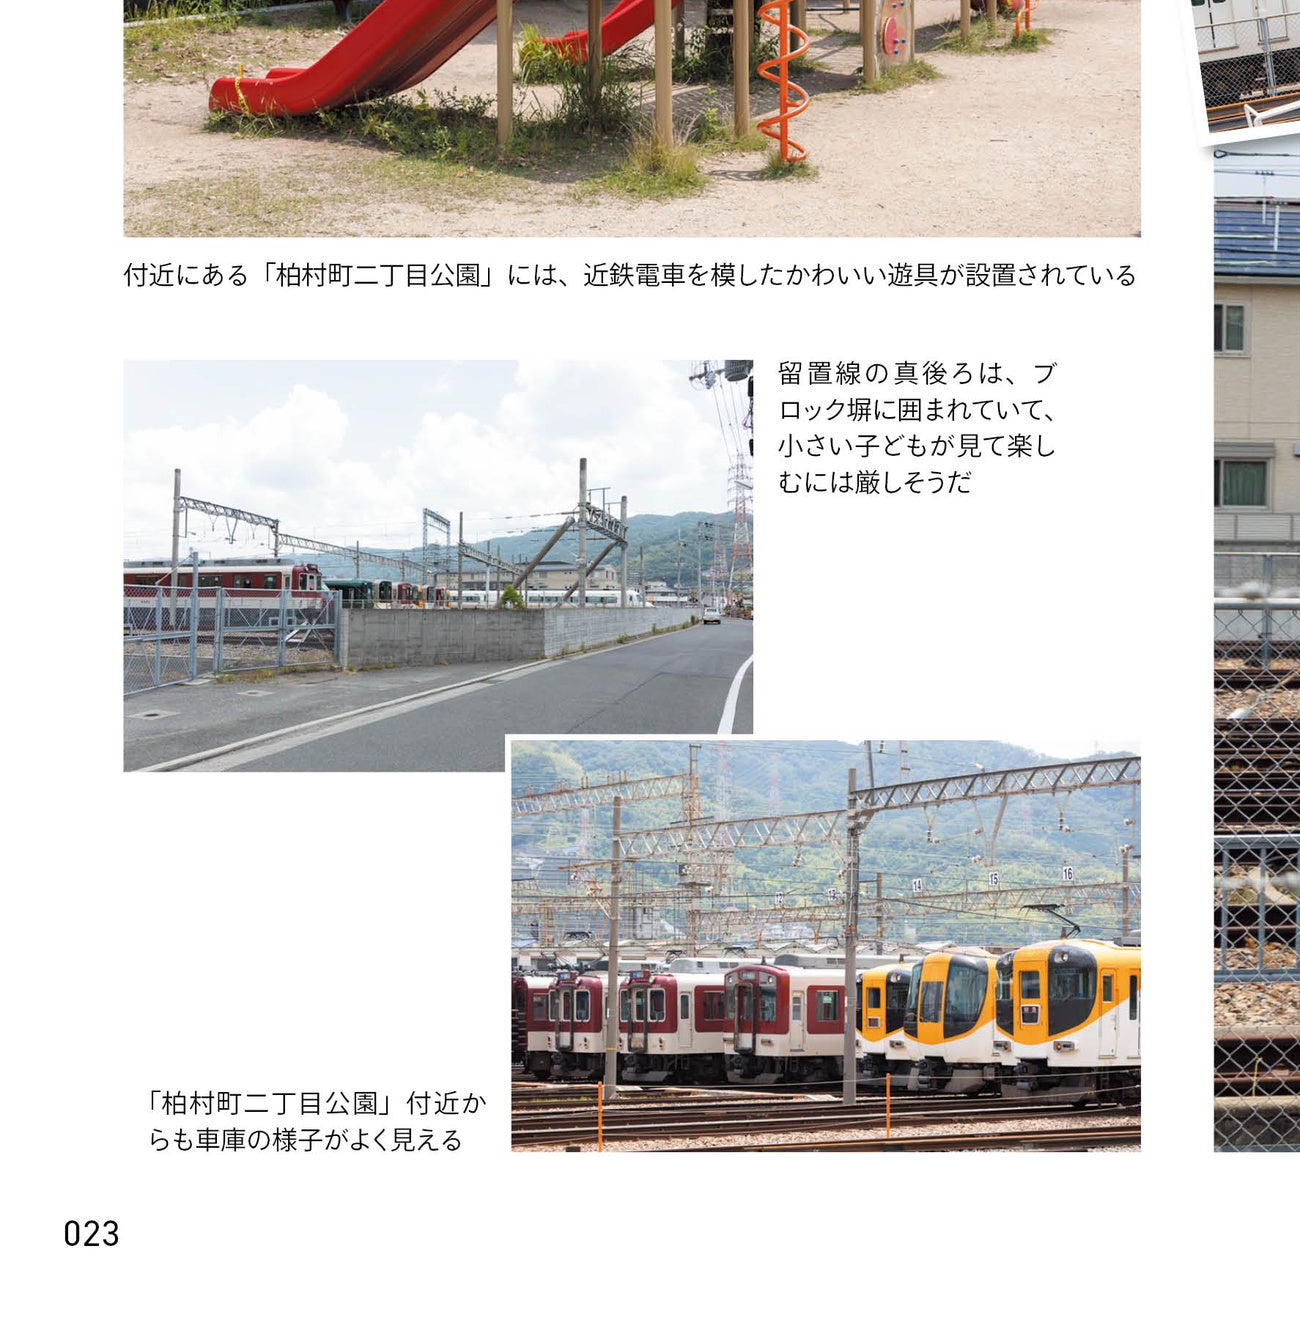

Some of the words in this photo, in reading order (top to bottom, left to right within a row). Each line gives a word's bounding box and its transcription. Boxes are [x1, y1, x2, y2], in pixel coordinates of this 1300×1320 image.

[124, 262, 1134, 287] 付近にある「柏村町二丁目公園」には、近鉄電車を模したかわいい遊具が設置されている
[779, 361, 1057, 385] 留置線の真後ろは、ブ
[782, 398, 1052, 422] ロック塀に囲まれていて、
[779, 433, 1054, 457] 小さい子どもが見て楽し
[780, 470, 971, 494] むには厳しそうだ
[912, 879, 923, 891] 14
[989, 872, 999, 885] 15
[1063, 867, 1073, 880] 16
[152, 1090, 486, 1115] 「柏村町二丁目公園」付近か
[151, 1127, 460, 1152] らも車庫の様子がよく見える
[65, 1220, 118, 1246] 023
